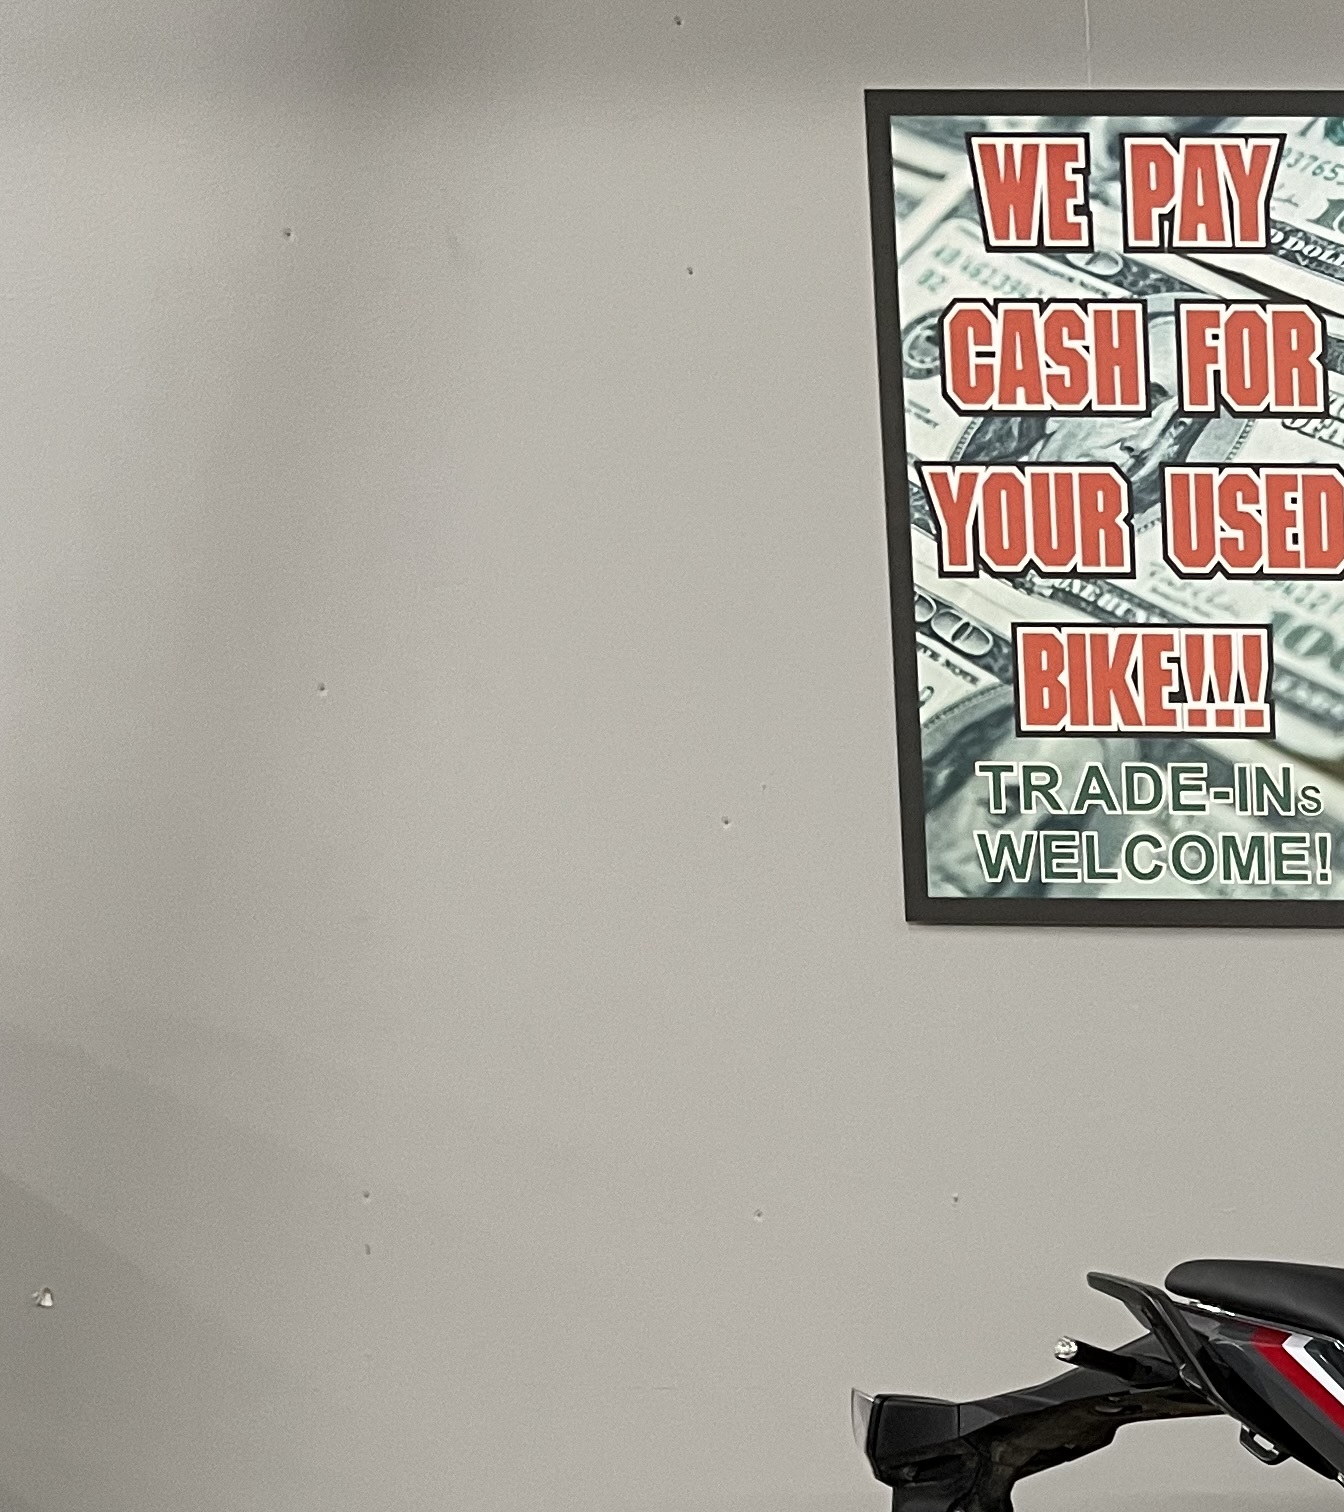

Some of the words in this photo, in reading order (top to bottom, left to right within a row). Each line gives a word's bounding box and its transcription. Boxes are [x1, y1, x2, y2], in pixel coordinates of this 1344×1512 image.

[973, 138, 1087, 246] WE
[1125, 137, 1276, 247] PAY
[944, 304, 1145, 411] CASH
[1181, 304, 1323, 412] FOR
[924, 467, 1129, 572] YOUR
[1017, 627, 1269, 732] BIKE!!!
[973, 830, 1331, 884] WELCOME!
